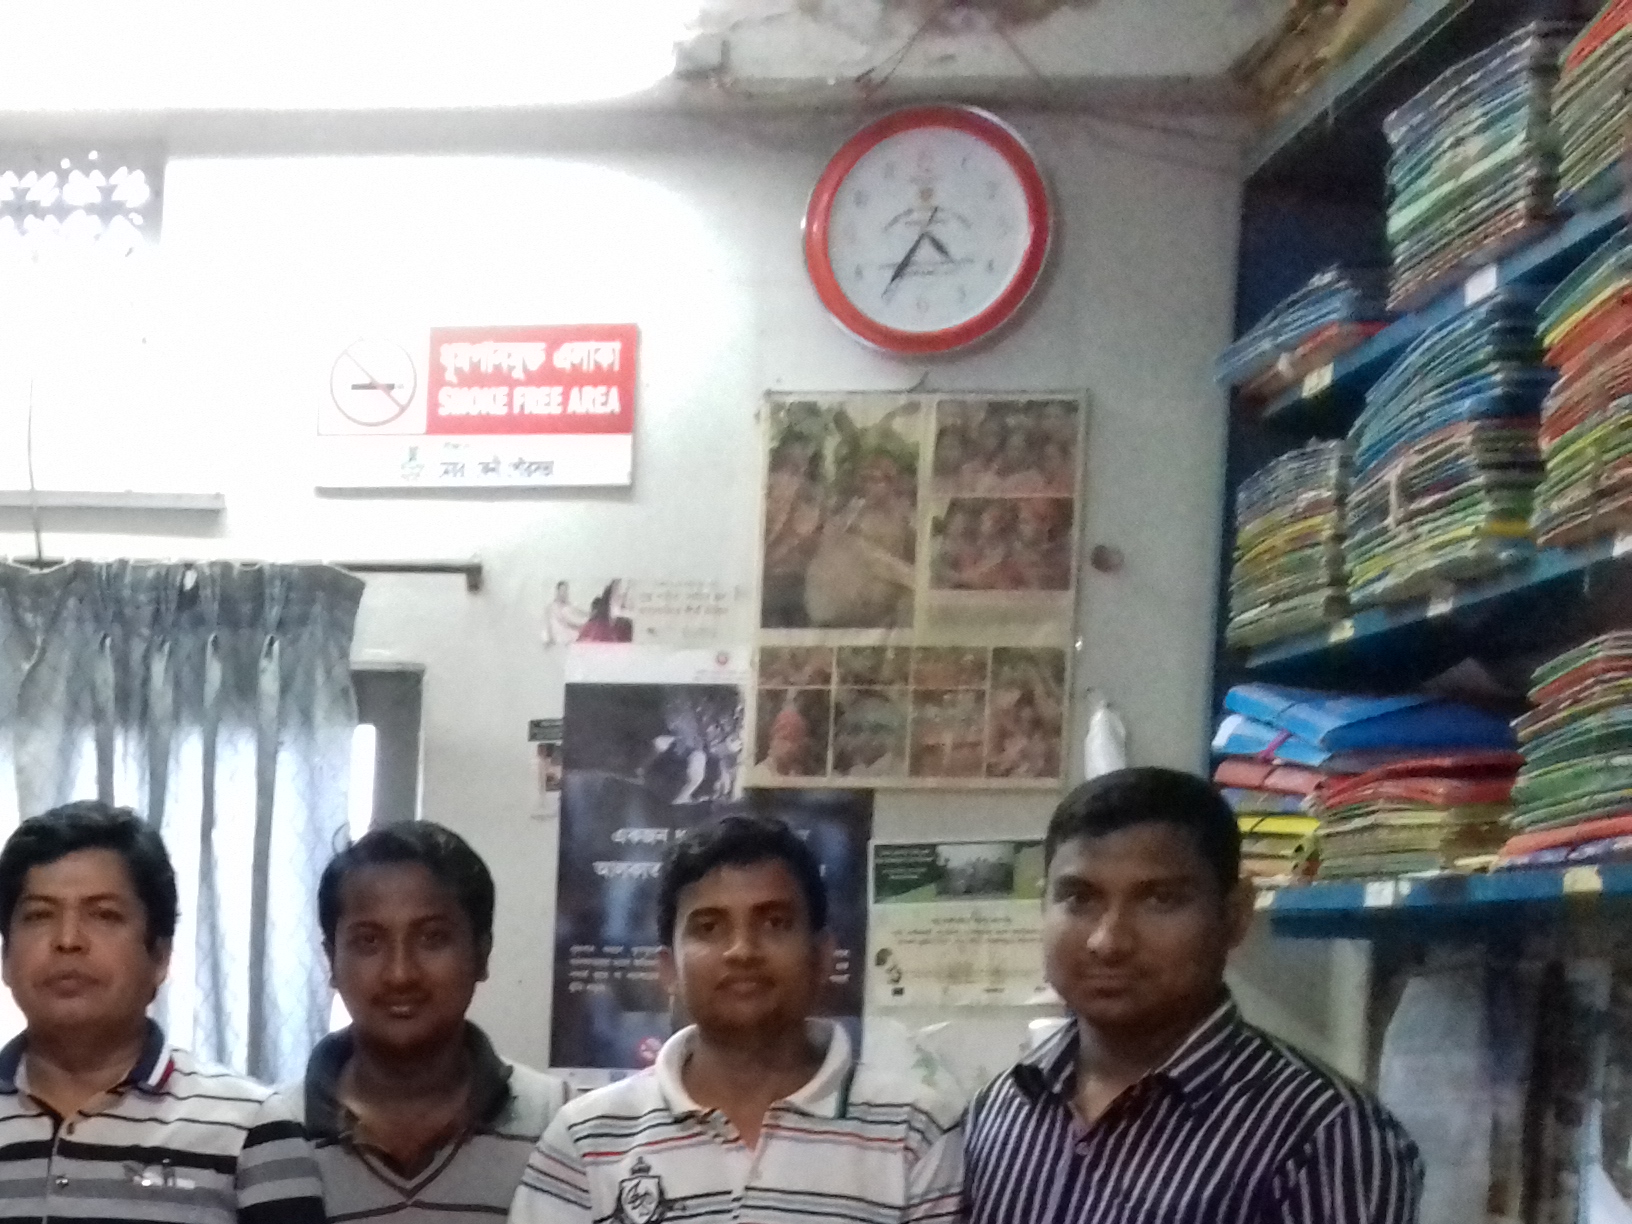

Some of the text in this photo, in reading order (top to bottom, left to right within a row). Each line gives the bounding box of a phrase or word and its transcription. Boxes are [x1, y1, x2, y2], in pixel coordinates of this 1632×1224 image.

[438, 385, 622, 416] SMOKE FREE AREA
